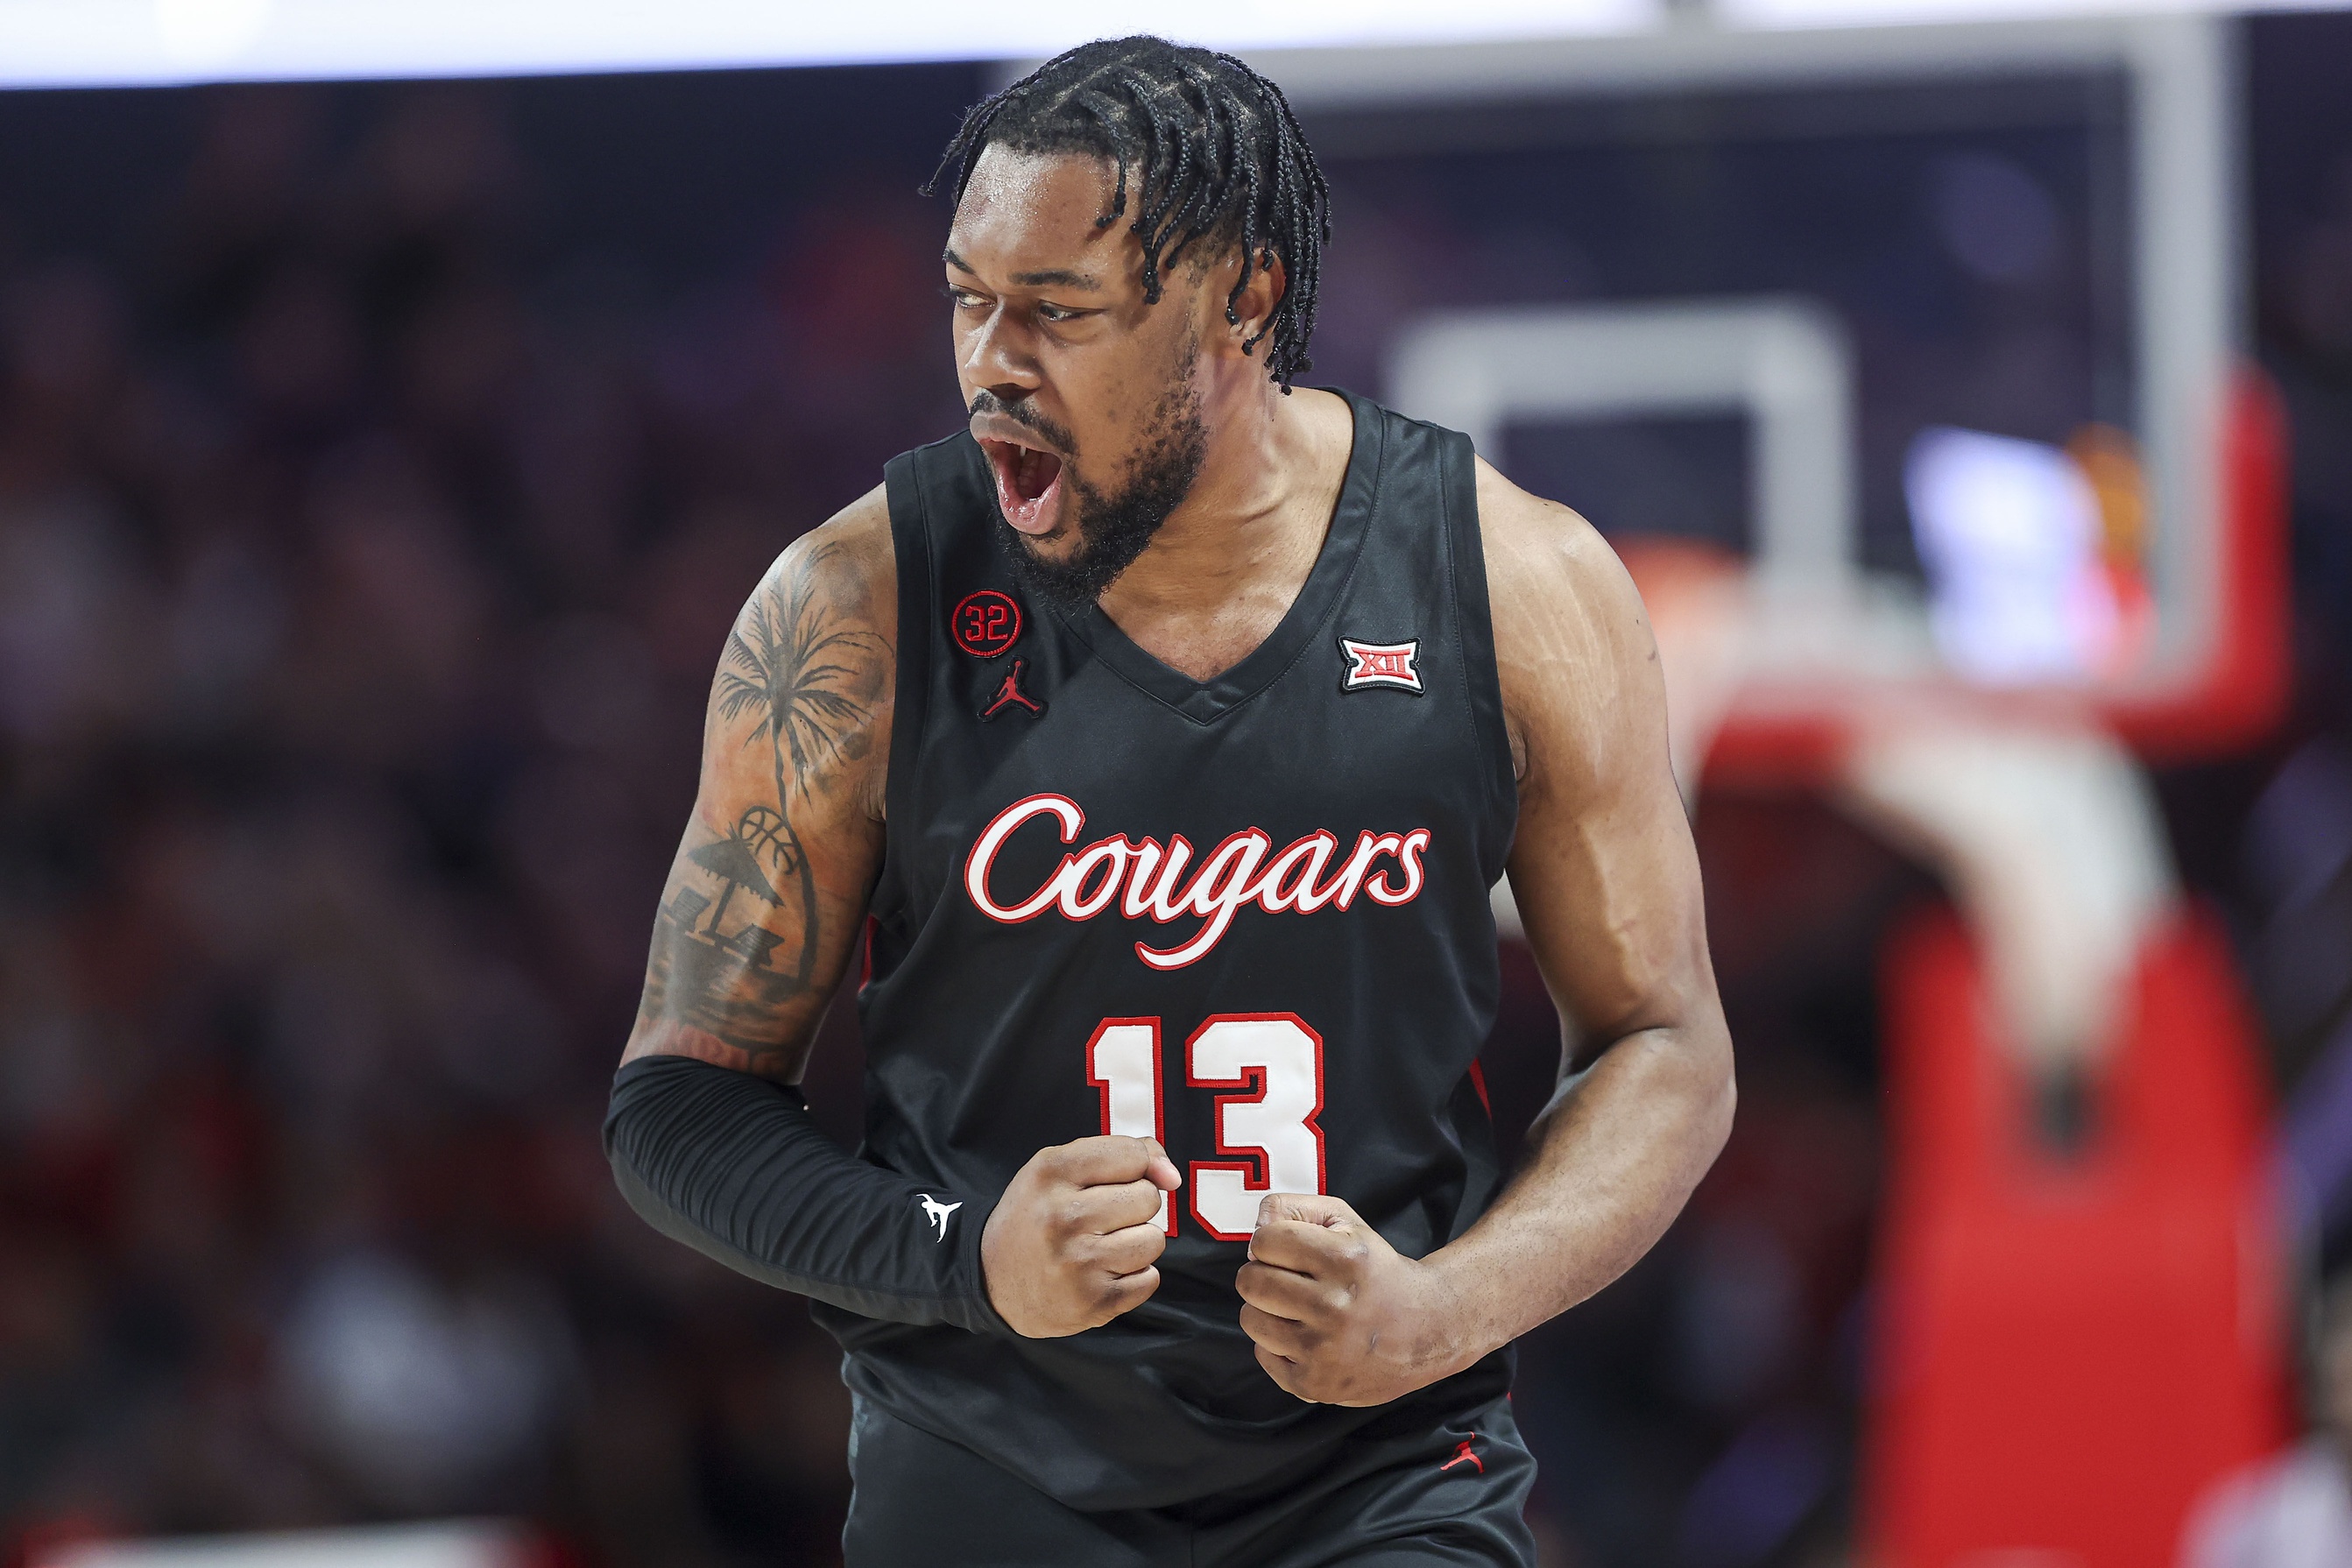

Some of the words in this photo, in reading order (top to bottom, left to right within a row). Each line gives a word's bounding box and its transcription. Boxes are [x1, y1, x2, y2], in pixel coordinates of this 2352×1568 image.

[965, 604, 1008, 641] 32
[1351, 646, 1414, 681] XII
[964, 793, 1430, 971] Cougars
[1085, 1012, 1326, 1241] 13
